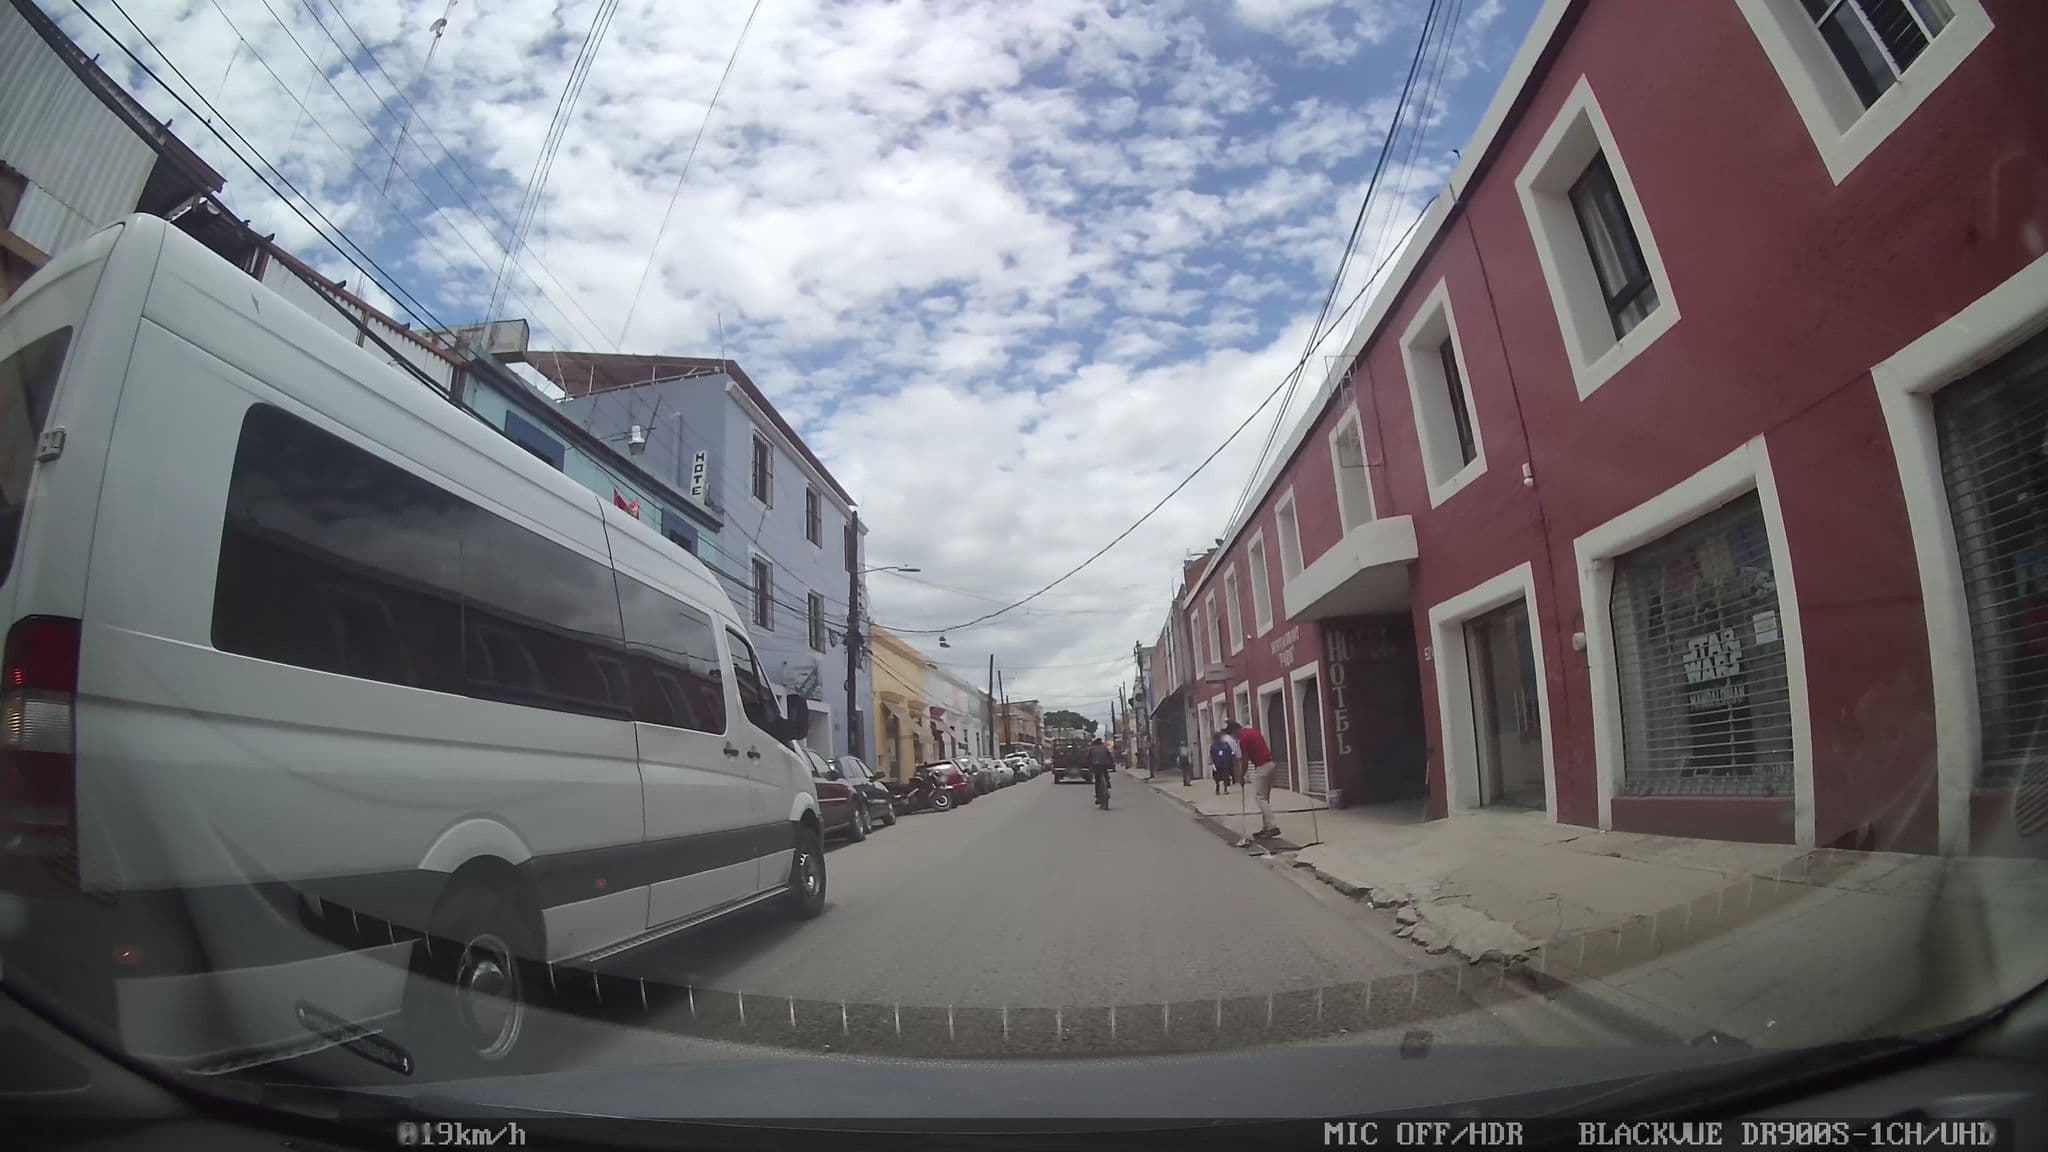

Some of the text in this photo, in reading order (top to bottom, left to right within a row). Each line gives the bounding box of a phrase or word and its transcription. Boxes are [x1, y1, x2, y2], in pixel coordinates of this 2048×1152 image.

[691, 452, 705, 496] HOTE
[1682, 629, 1742, 663] STAR
[1684, 651, 1743, 684] WARS
[1327, 630, 1352, 755] HOTEL
